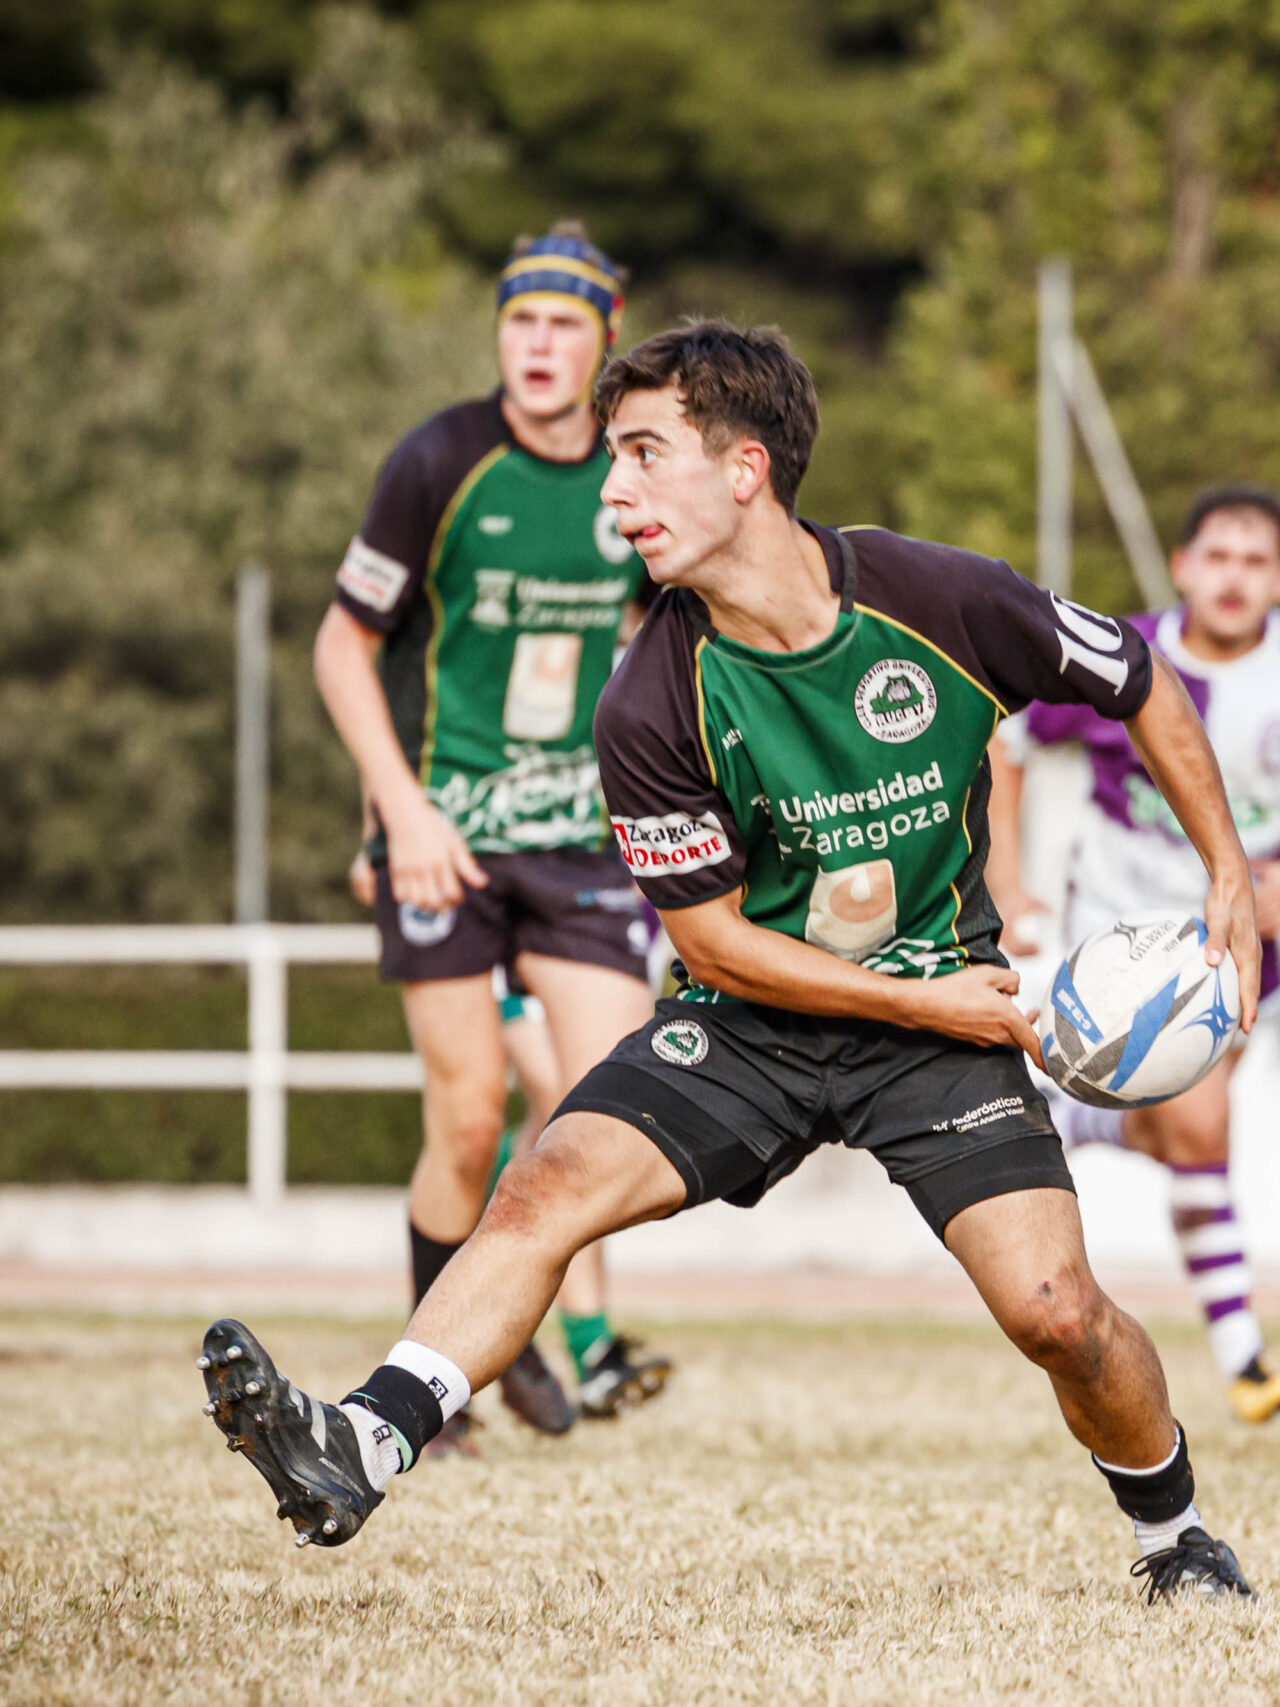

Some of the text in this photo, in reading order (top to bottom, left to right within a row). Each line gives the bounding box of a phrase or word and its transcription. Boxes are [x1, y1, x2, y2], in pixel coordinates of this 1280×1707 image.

[1049, 588, 1129, 697] 10
[779, 760, 944, 824] Universidad
[633, 836, 723, 868] DEPORTE
[792, 800, 951, 856] Zaragoza
